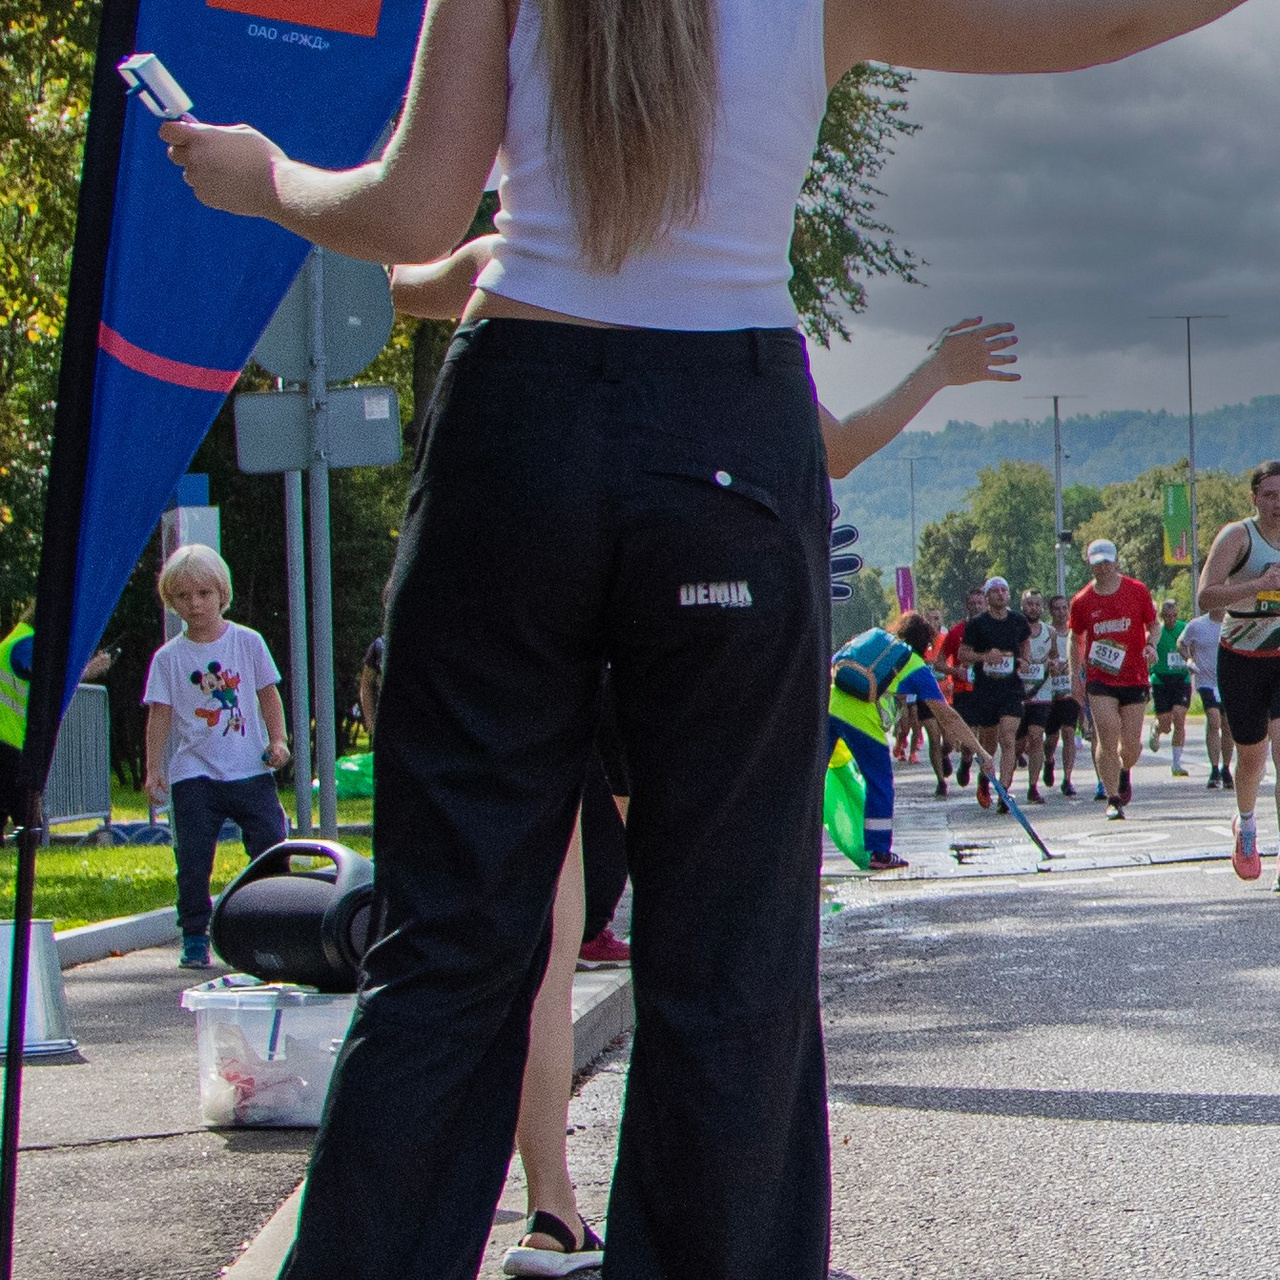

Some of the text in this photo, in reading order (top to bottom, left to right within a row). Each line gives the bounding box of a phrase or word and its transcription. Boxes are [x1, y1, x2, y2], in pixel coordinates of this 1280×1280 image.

[248, 23, 330, 51] ОАО «РЖД»
[1095, 644, 1121, 662] 2519
